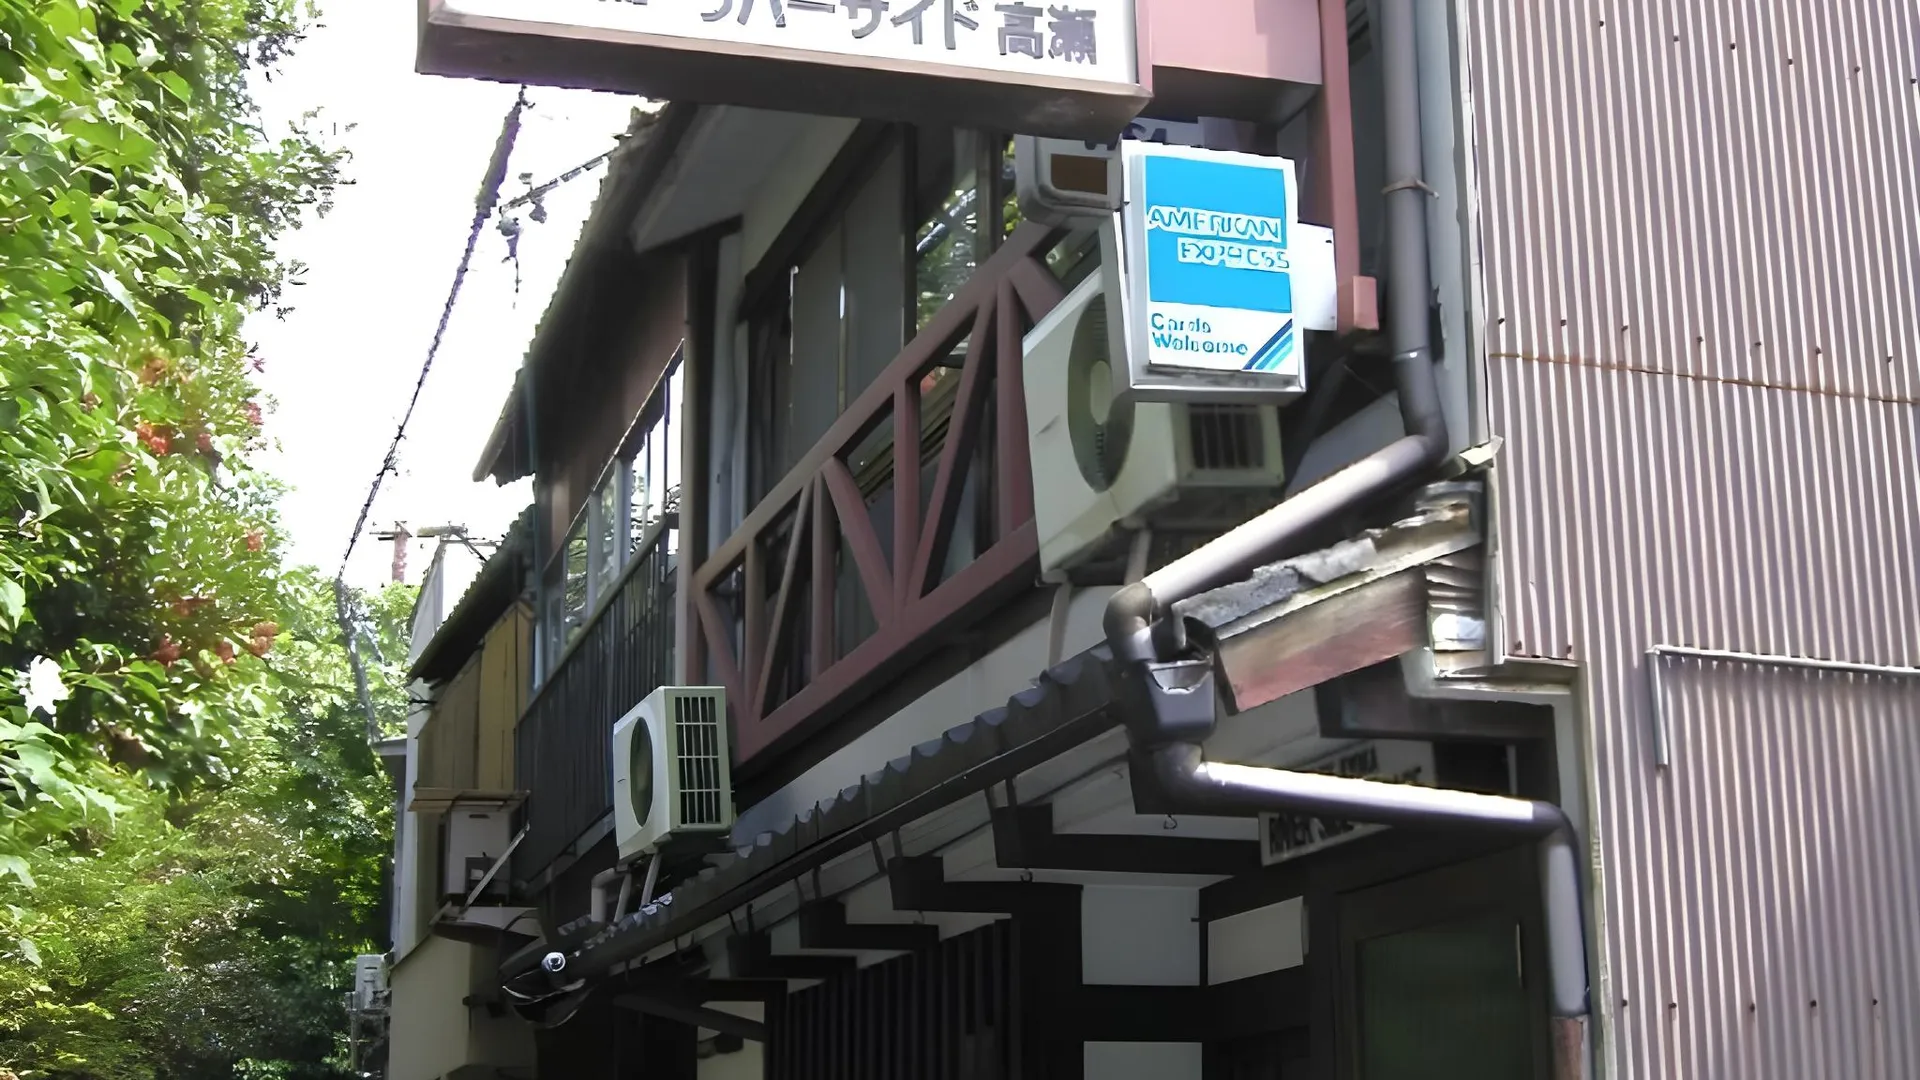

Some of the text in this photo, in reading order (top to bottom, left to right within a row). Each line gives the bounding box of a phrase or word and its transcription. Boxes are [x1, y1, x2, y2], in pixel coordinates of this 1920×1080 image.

[1148, 207, 1280, 239] AMERICAN
[1181, 241, 1290, 269] EXPRESS
[1151, 312, 1212, 334] Cards
[1152, 332, 1249, 355] Welcome
